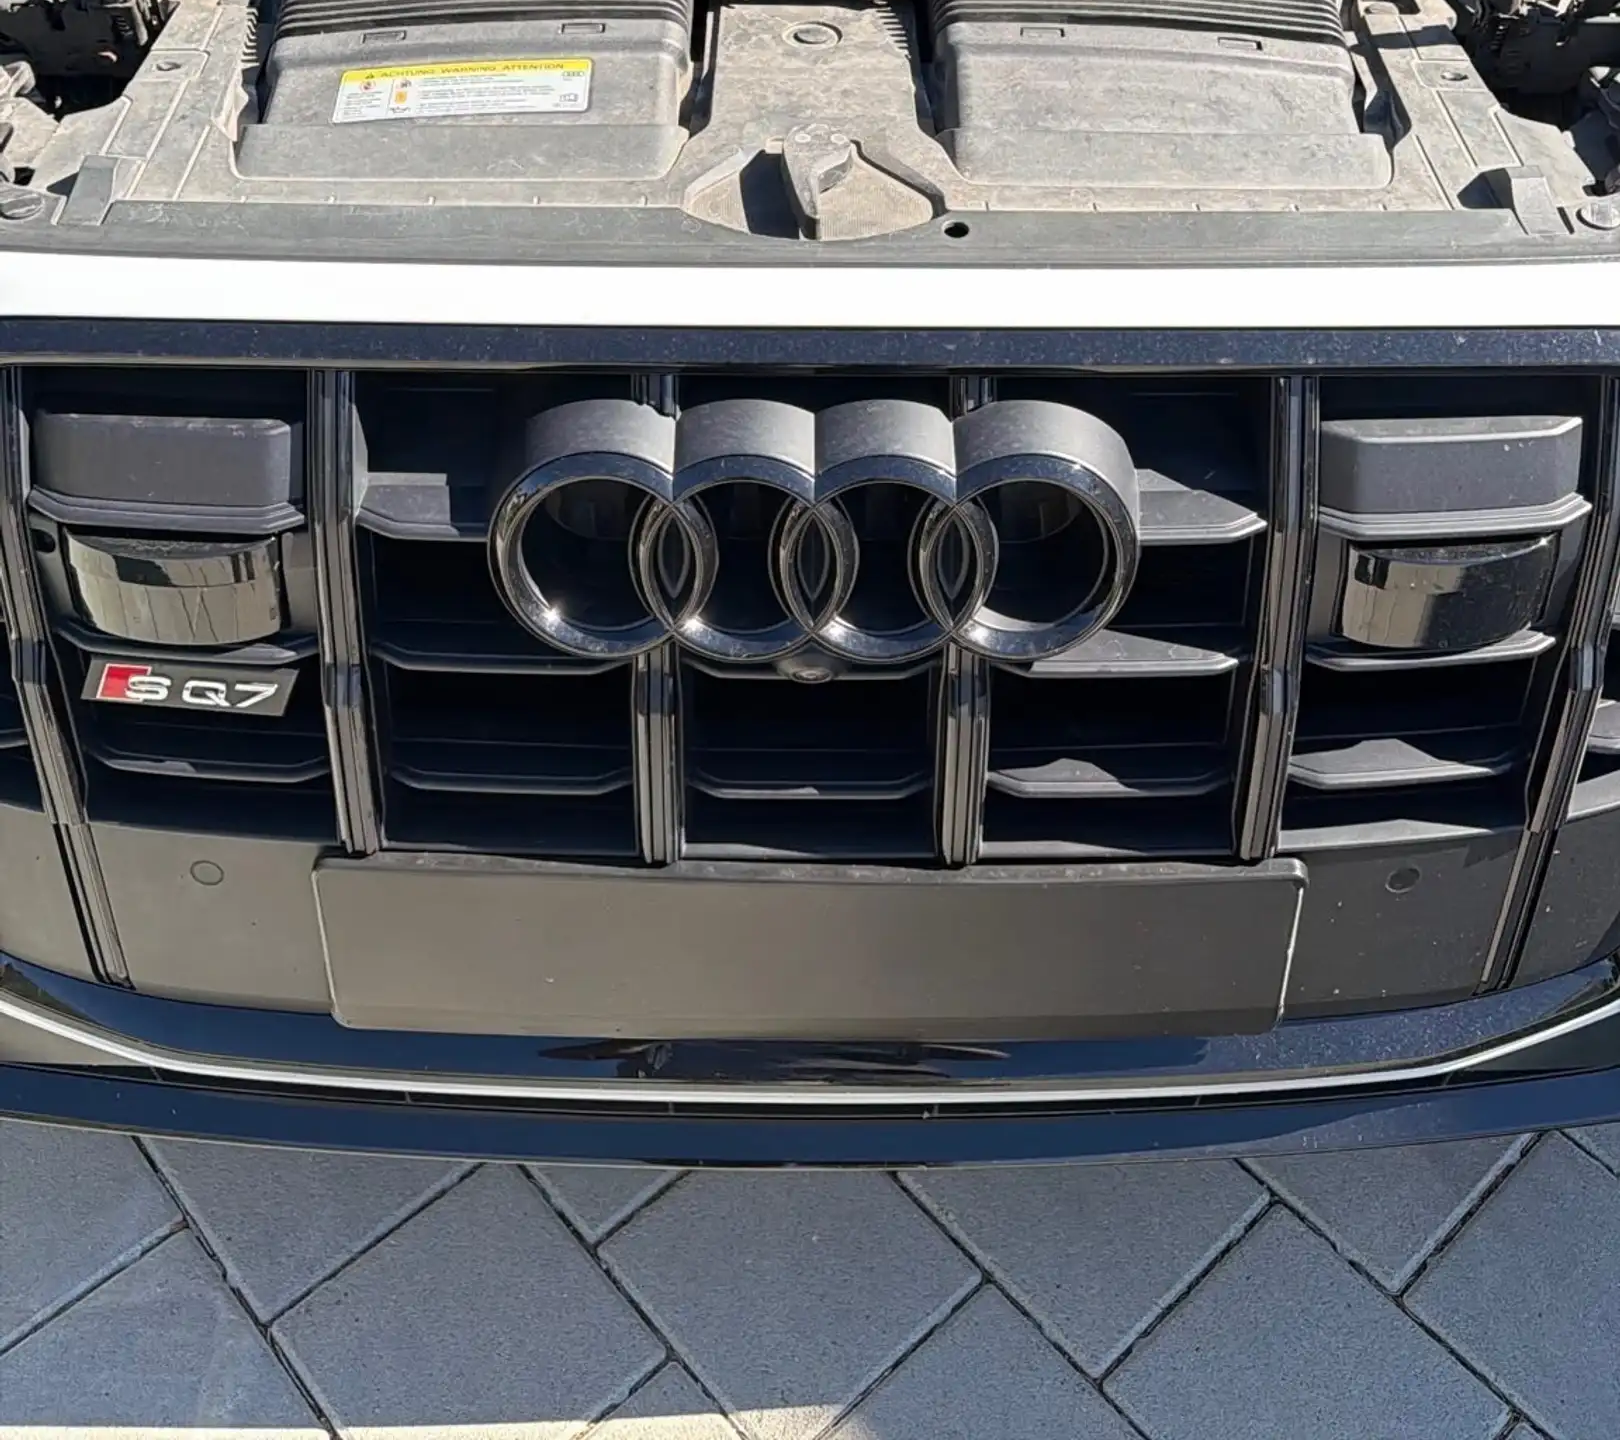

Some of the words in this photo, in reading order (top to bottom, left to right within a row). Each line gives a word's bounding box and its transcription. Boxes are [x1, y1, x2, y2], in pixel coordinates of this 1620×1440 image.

[380, 68, 436, 79] ACHTUNG
[441, 65, 497, 75] WARNING
[502, 62, 565, 72] ATTENTION
